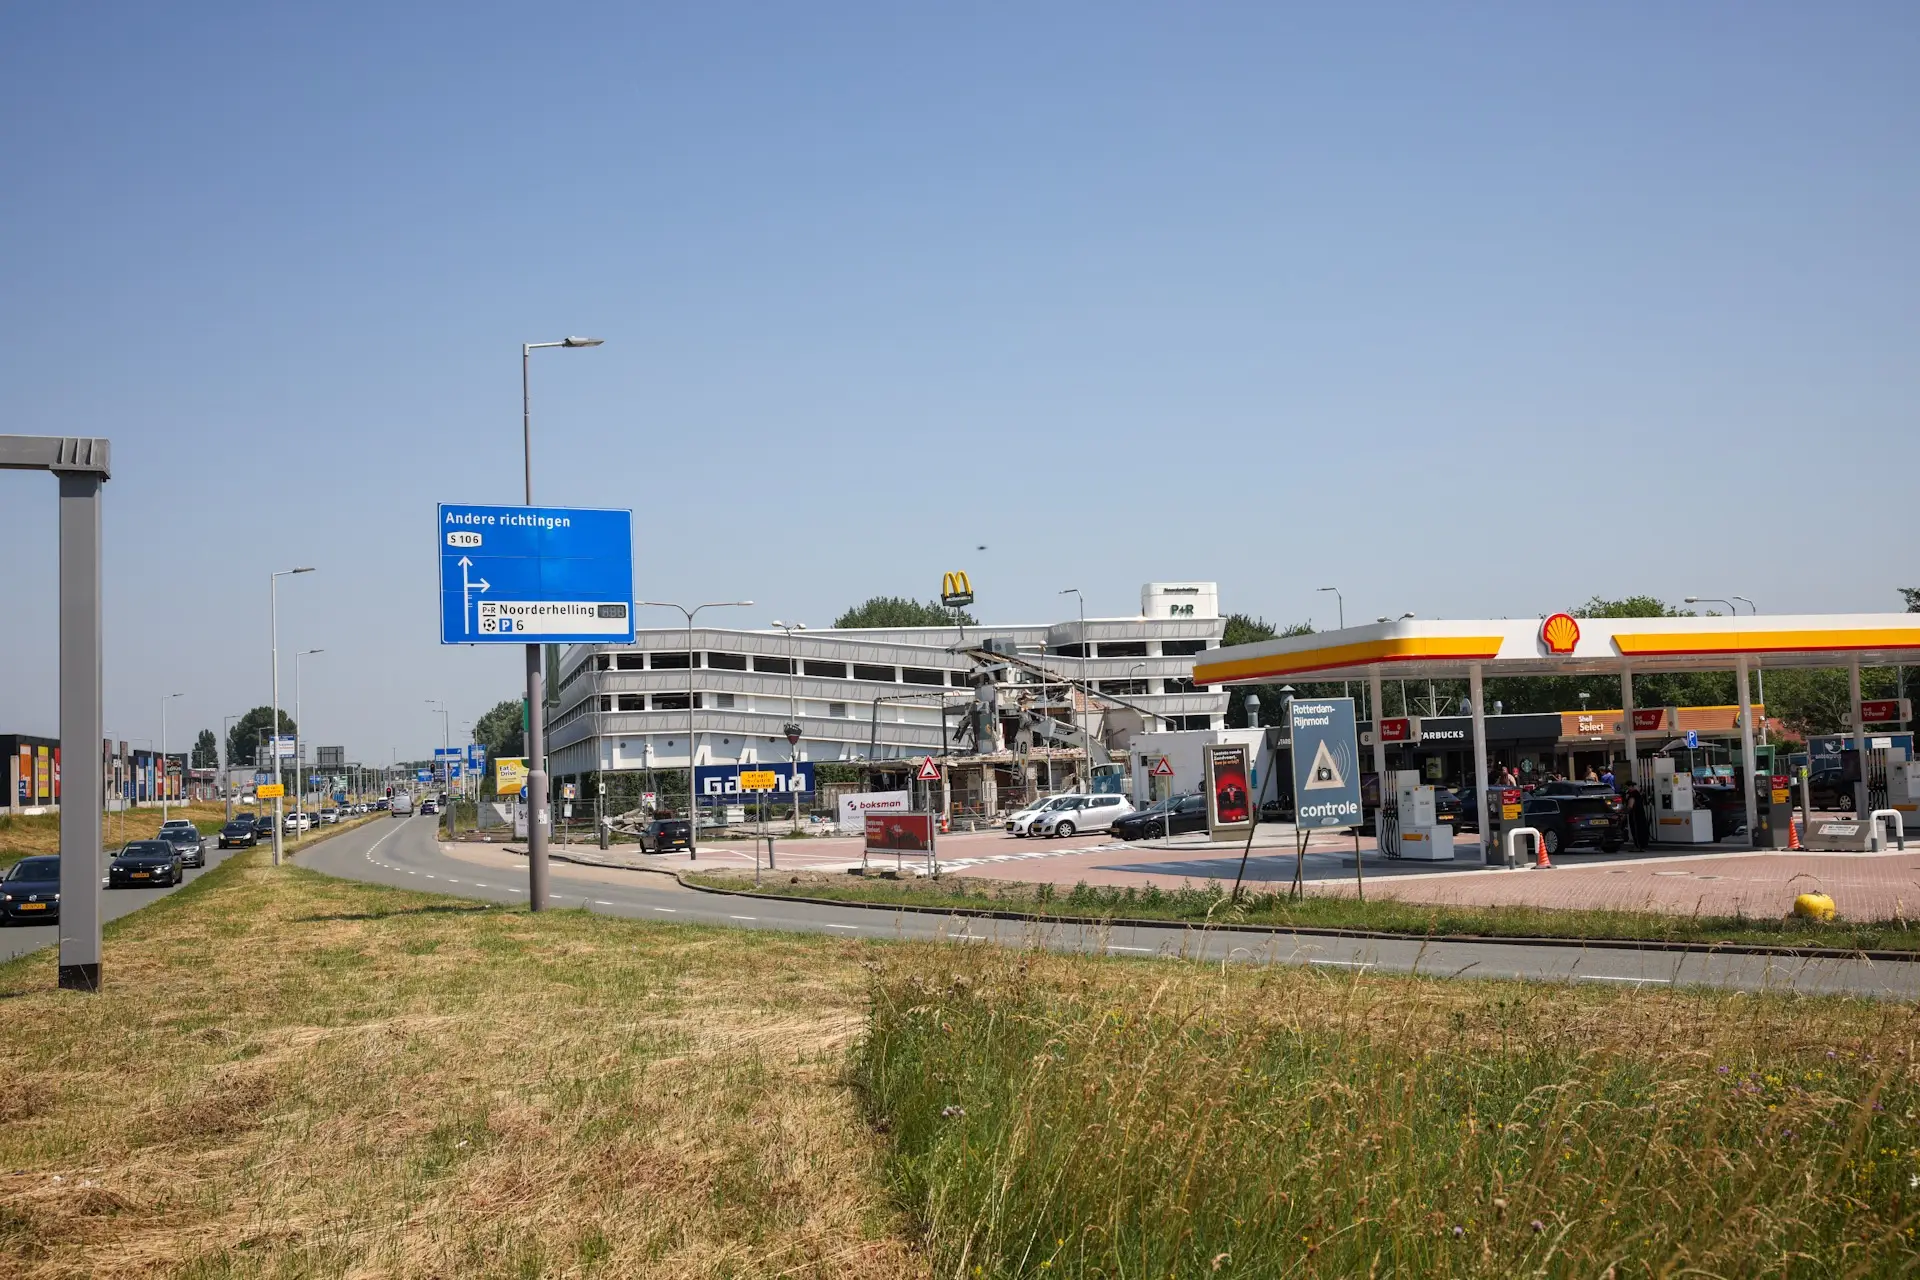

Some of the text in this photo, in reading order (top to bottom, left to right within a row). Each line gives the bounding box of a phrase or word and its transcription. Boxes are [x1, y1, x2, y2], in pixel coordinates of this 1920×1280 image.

[445, 512, 571, 530] Andere richtingen
[450, 534, 480, 544] S 106
[500, 603, 595, 618] Noorderhelling
[1170, 604, 1194, 616] P+R
[516, 619, 524, 631] 6
[1292, 703, 1336, 715] Rotterdam-
[1293, 715, 1329, 730] Rijnmond
[1579, 722, 1604, 732] Select
[1616, 724, 1621, 732] 6
[1364, 734, 1369, 742] 8
[1421, 730, 1464, 740] ARBUCKS
[704, 773, 806, 795] Gaa
[860, 800, 902, 809] boksman
[1300, 800, 1358, 818] controle
